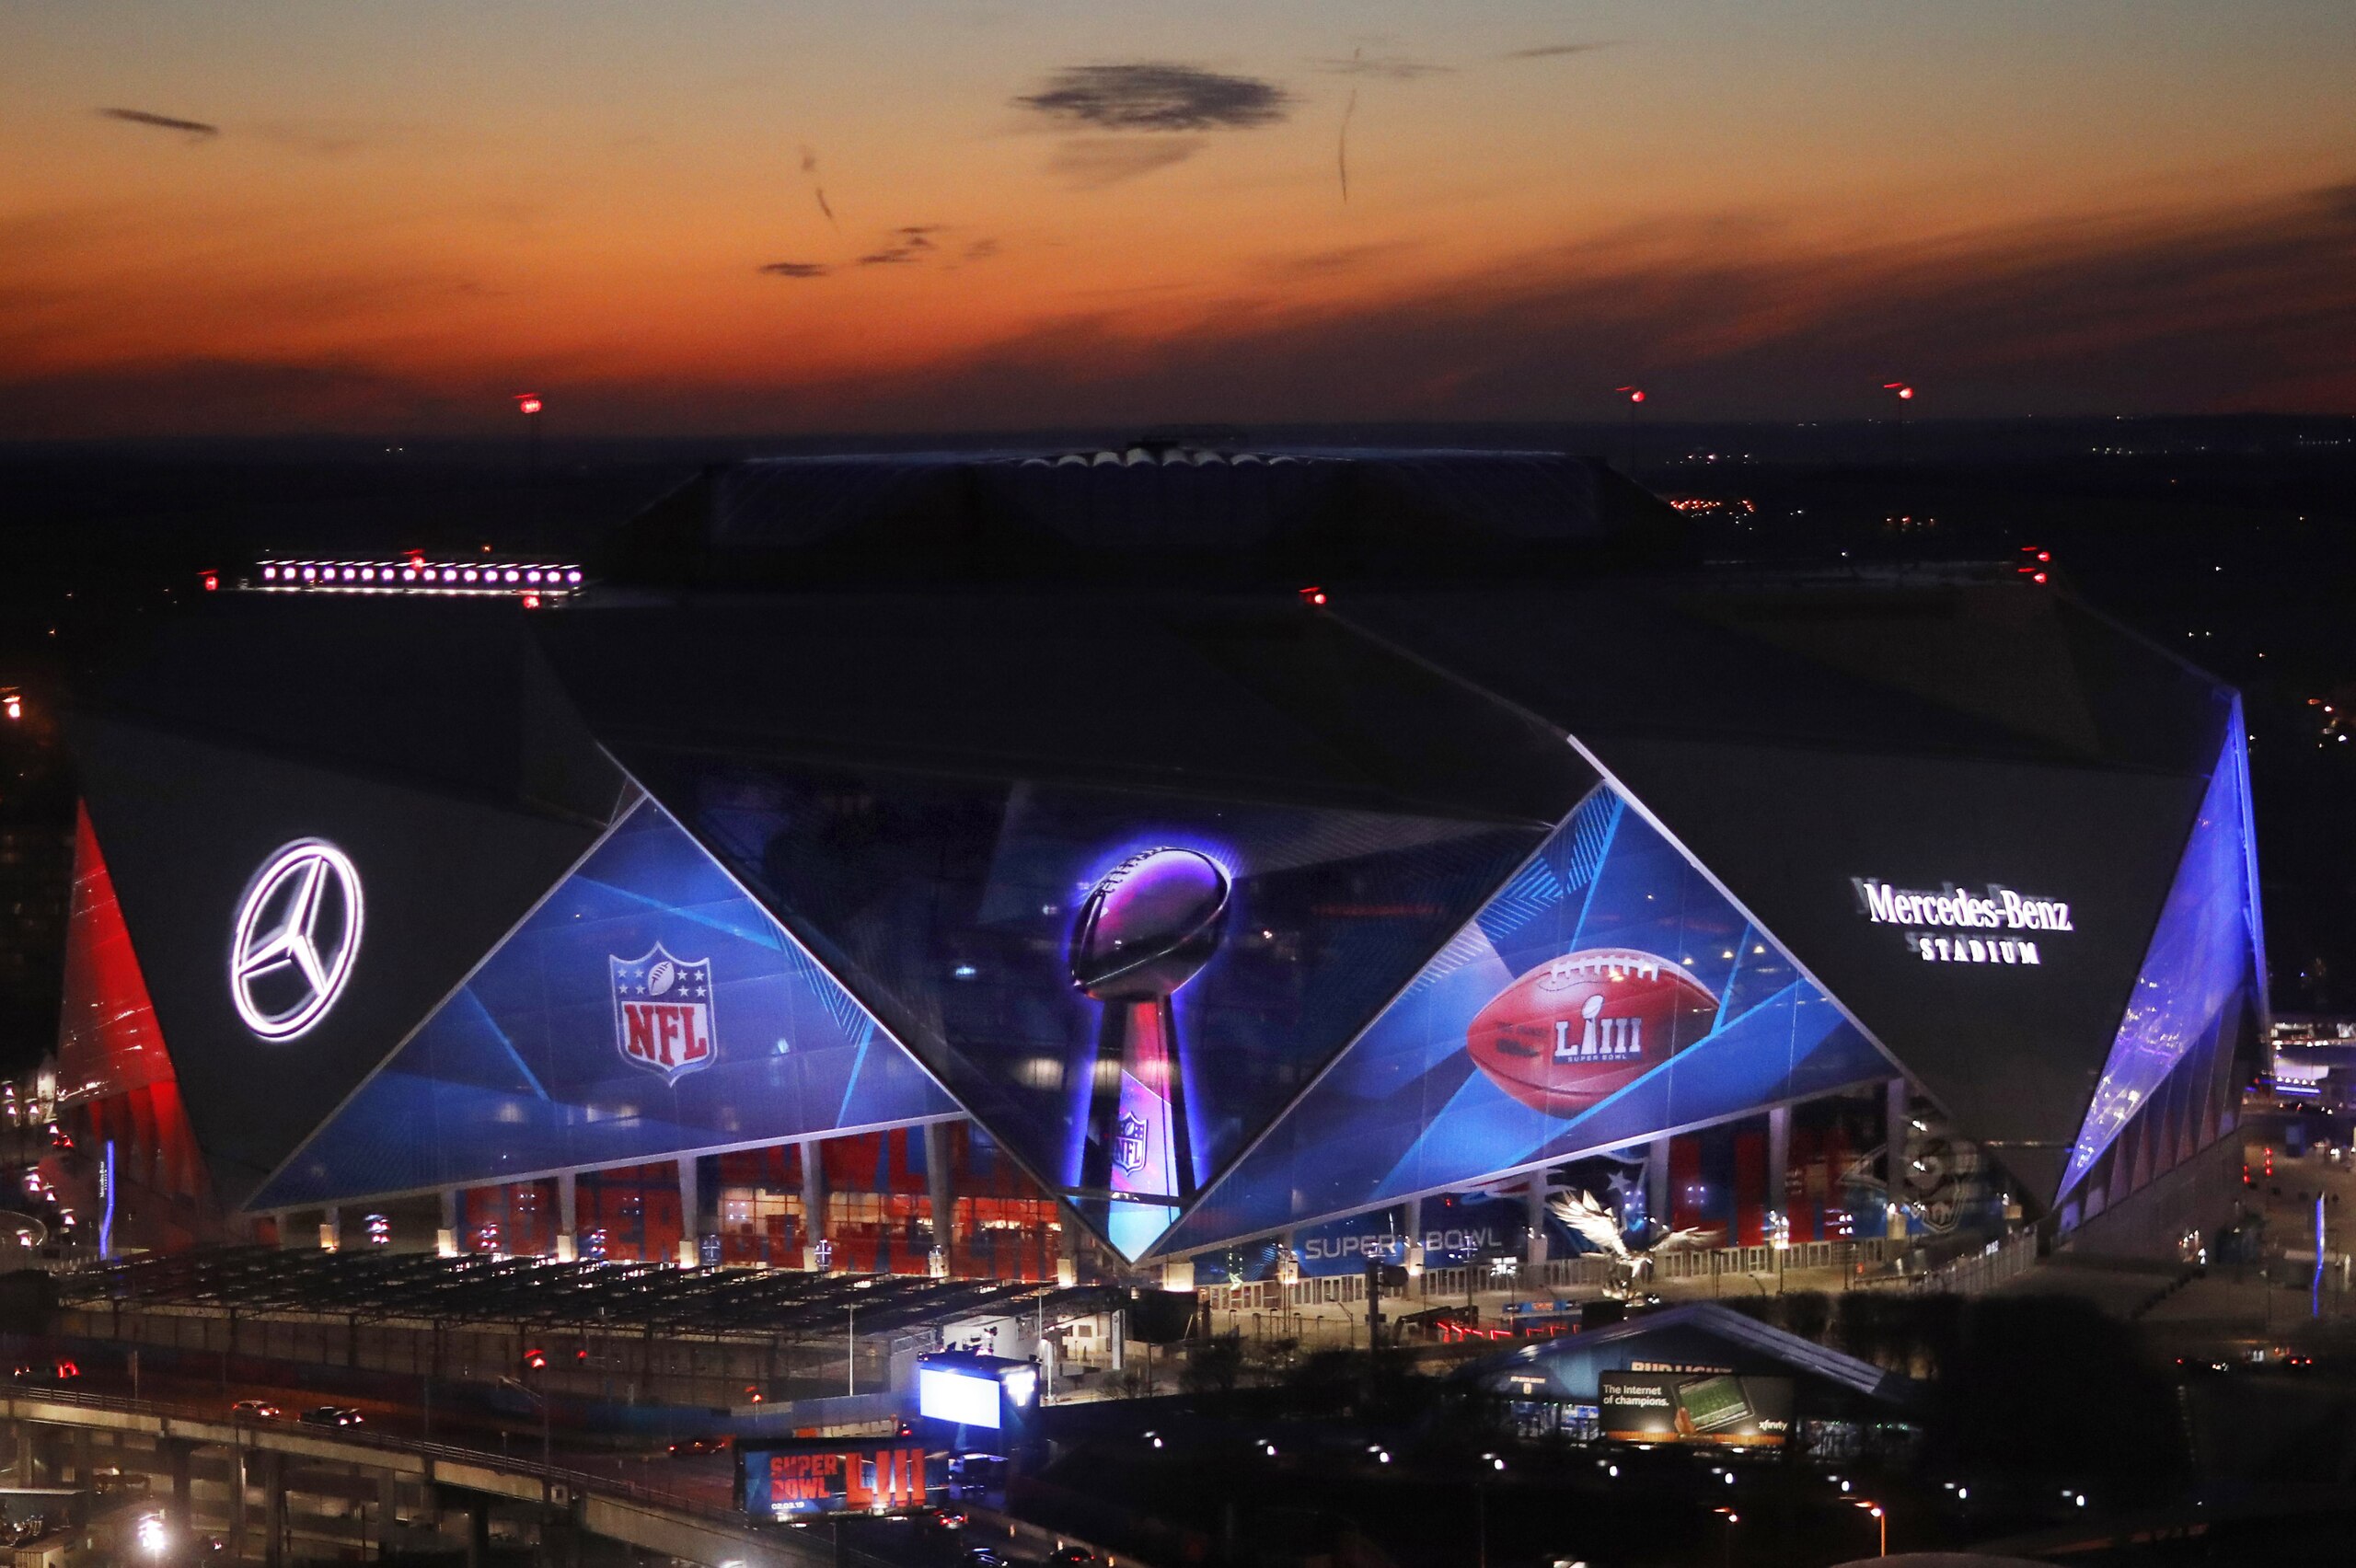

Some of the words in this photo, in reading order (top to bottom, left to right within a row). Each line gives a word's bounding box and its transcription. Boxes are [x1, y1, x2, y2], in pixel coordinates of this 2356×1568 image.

[1863, 882, 2073, 931] Mercedes-Benz
[1919, 938, 2040, 965] STADIUM
[624, 1003, 708, 1067] NFL
[1567, 1055, 1599, 1063] SUPER
[1115, 1138, 1141, 1166] NFL
[1305, 1234, 1397, 1260] SUPER
[1426, 1227, 1502, 1251] BOWL
[1603, 1384, 1622, 1394] The
[1623, 1385, 1662, 1396] Internet
[1603, 1395, 1613, 1404] of
[1615, 1396, 1669, 1408] champions.
[770, 1453, 838, 1477] SUPER
[845, 1447, 927, 1508] LIII
[770, 1476, 830, 1501] BOWL
